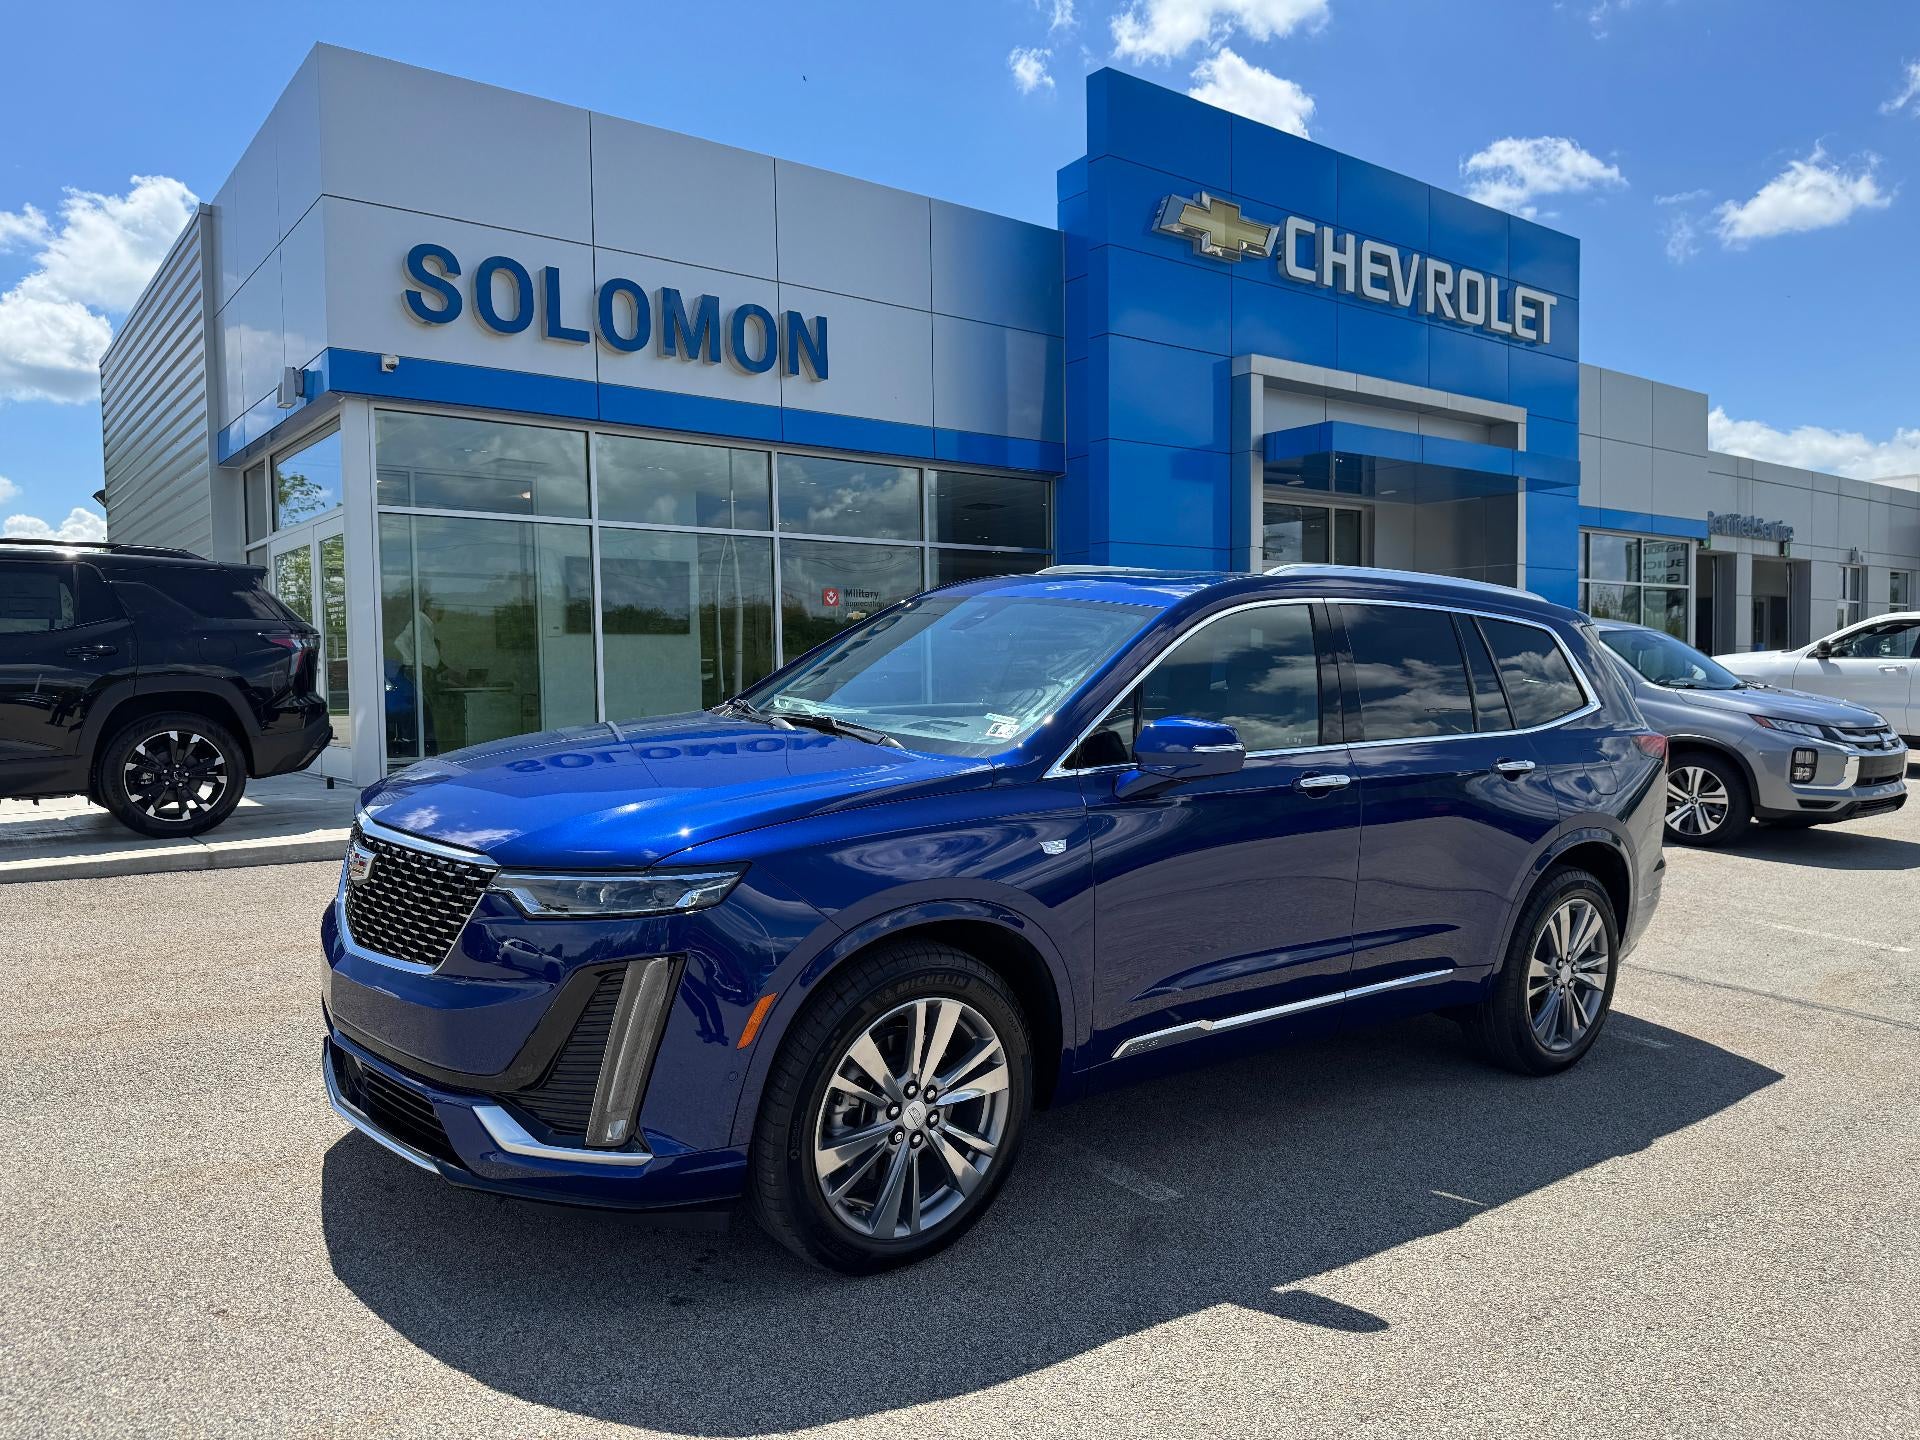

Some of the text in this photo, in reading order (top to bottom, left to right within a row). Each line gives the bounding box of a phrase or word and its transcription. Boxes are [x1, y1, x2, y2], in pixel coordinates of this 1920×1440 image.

[402, 243, 829, 382] SOLOMON
[1278, 215, 1558, 346] CHEVROLET
[844, 588, 879, 600] Military
[896, 973, 968, 993] MICHELIN
